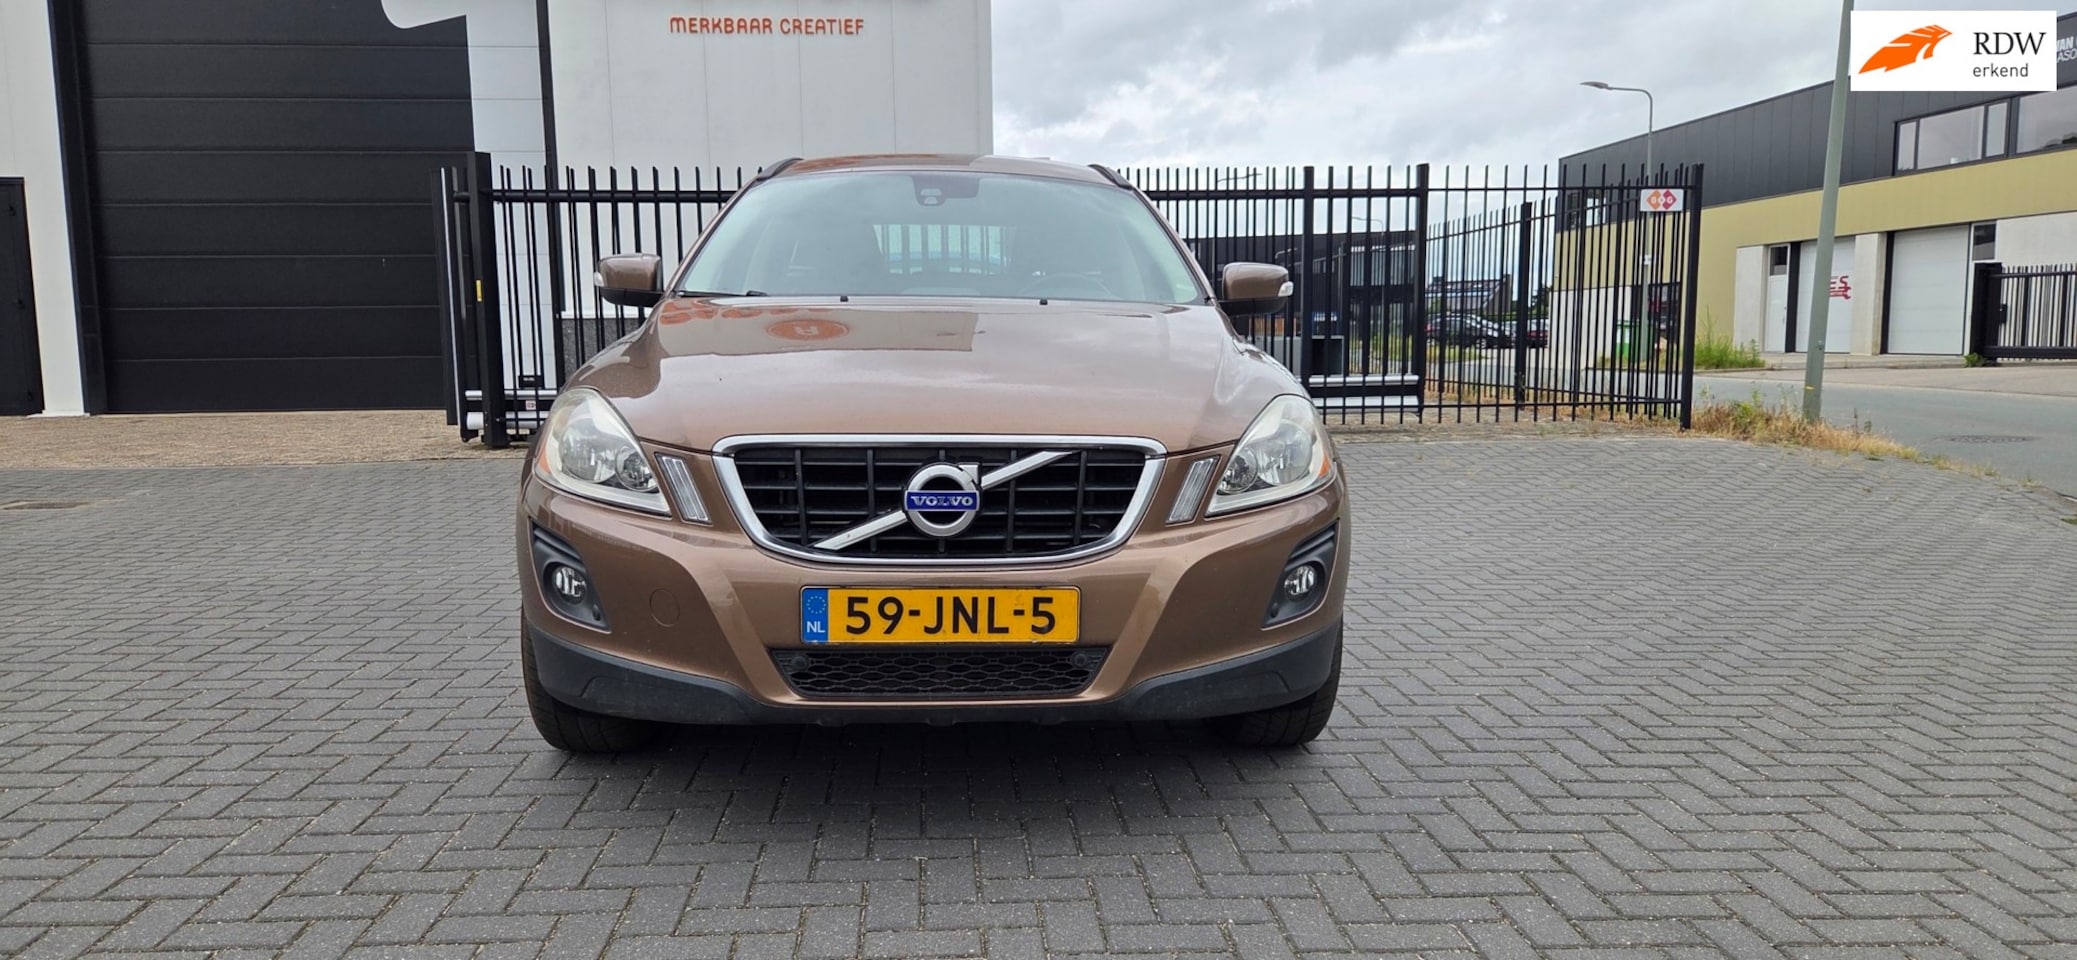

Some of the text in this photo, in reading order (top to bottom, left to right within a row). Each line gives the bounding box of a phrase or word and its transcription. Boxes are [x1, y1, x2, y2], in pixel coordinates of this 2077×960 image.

[669, 16, 865, 35] MERKBAAR CREATIEF
[910, 496, 974, 507] VOLVO
[846, 596, 1056, 635] 59-JNL-5
[806, 621, 826, 633] NL
